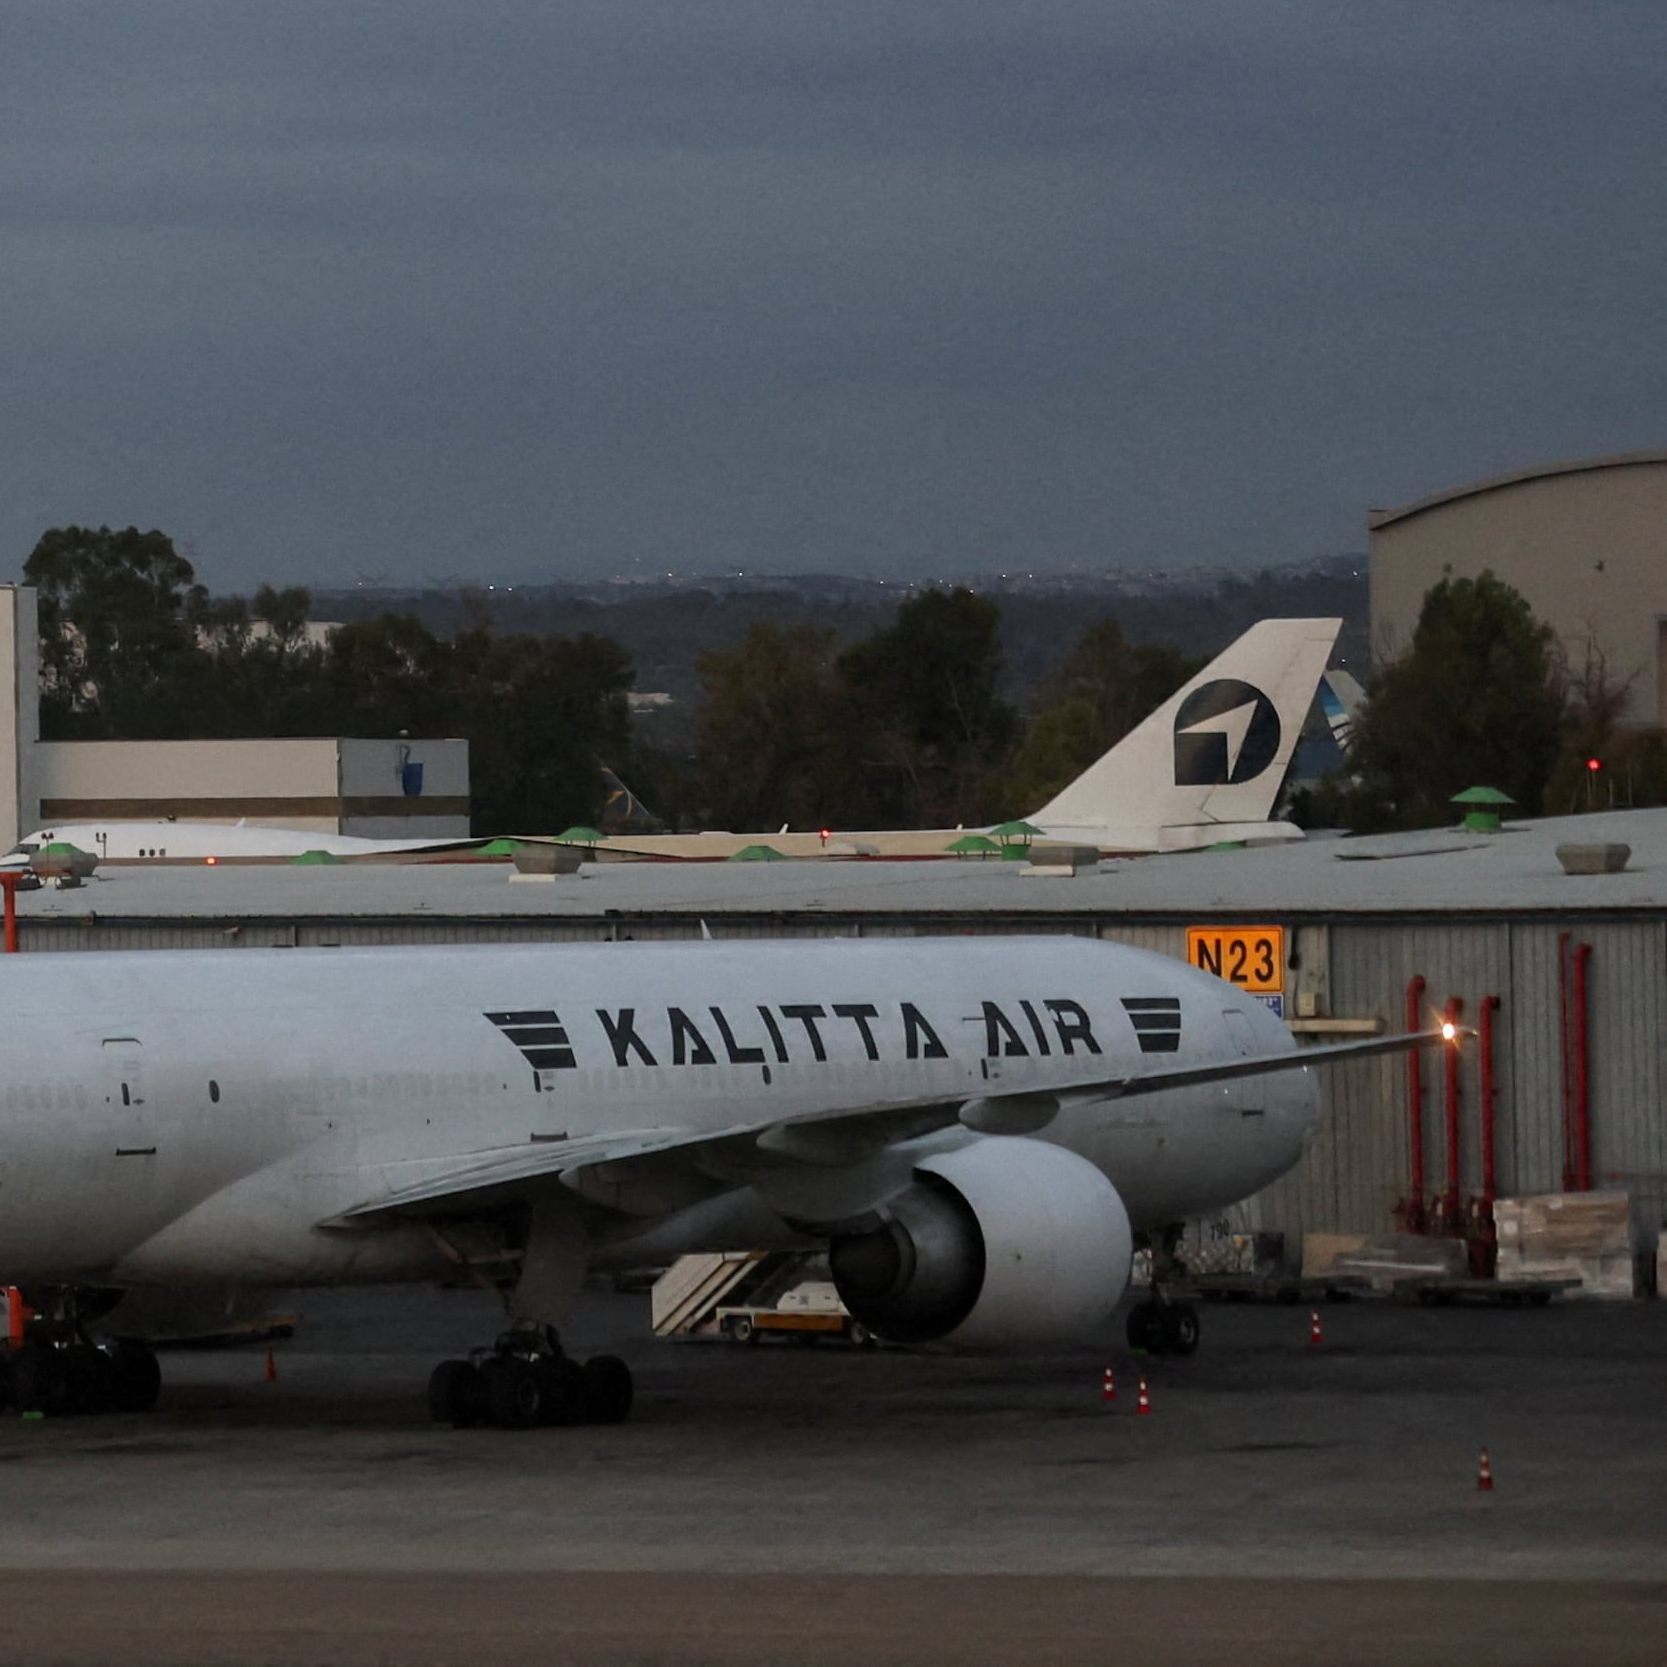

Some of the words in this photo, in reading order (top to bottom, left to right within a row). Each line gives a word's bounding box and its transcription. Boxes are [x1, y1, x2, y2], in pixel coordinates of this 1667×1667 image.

[1196, 938, 1274, 983] N23
[595, 1001, 950, 1068] KALITTA
[981, 998, 1104, 1057] AIR
